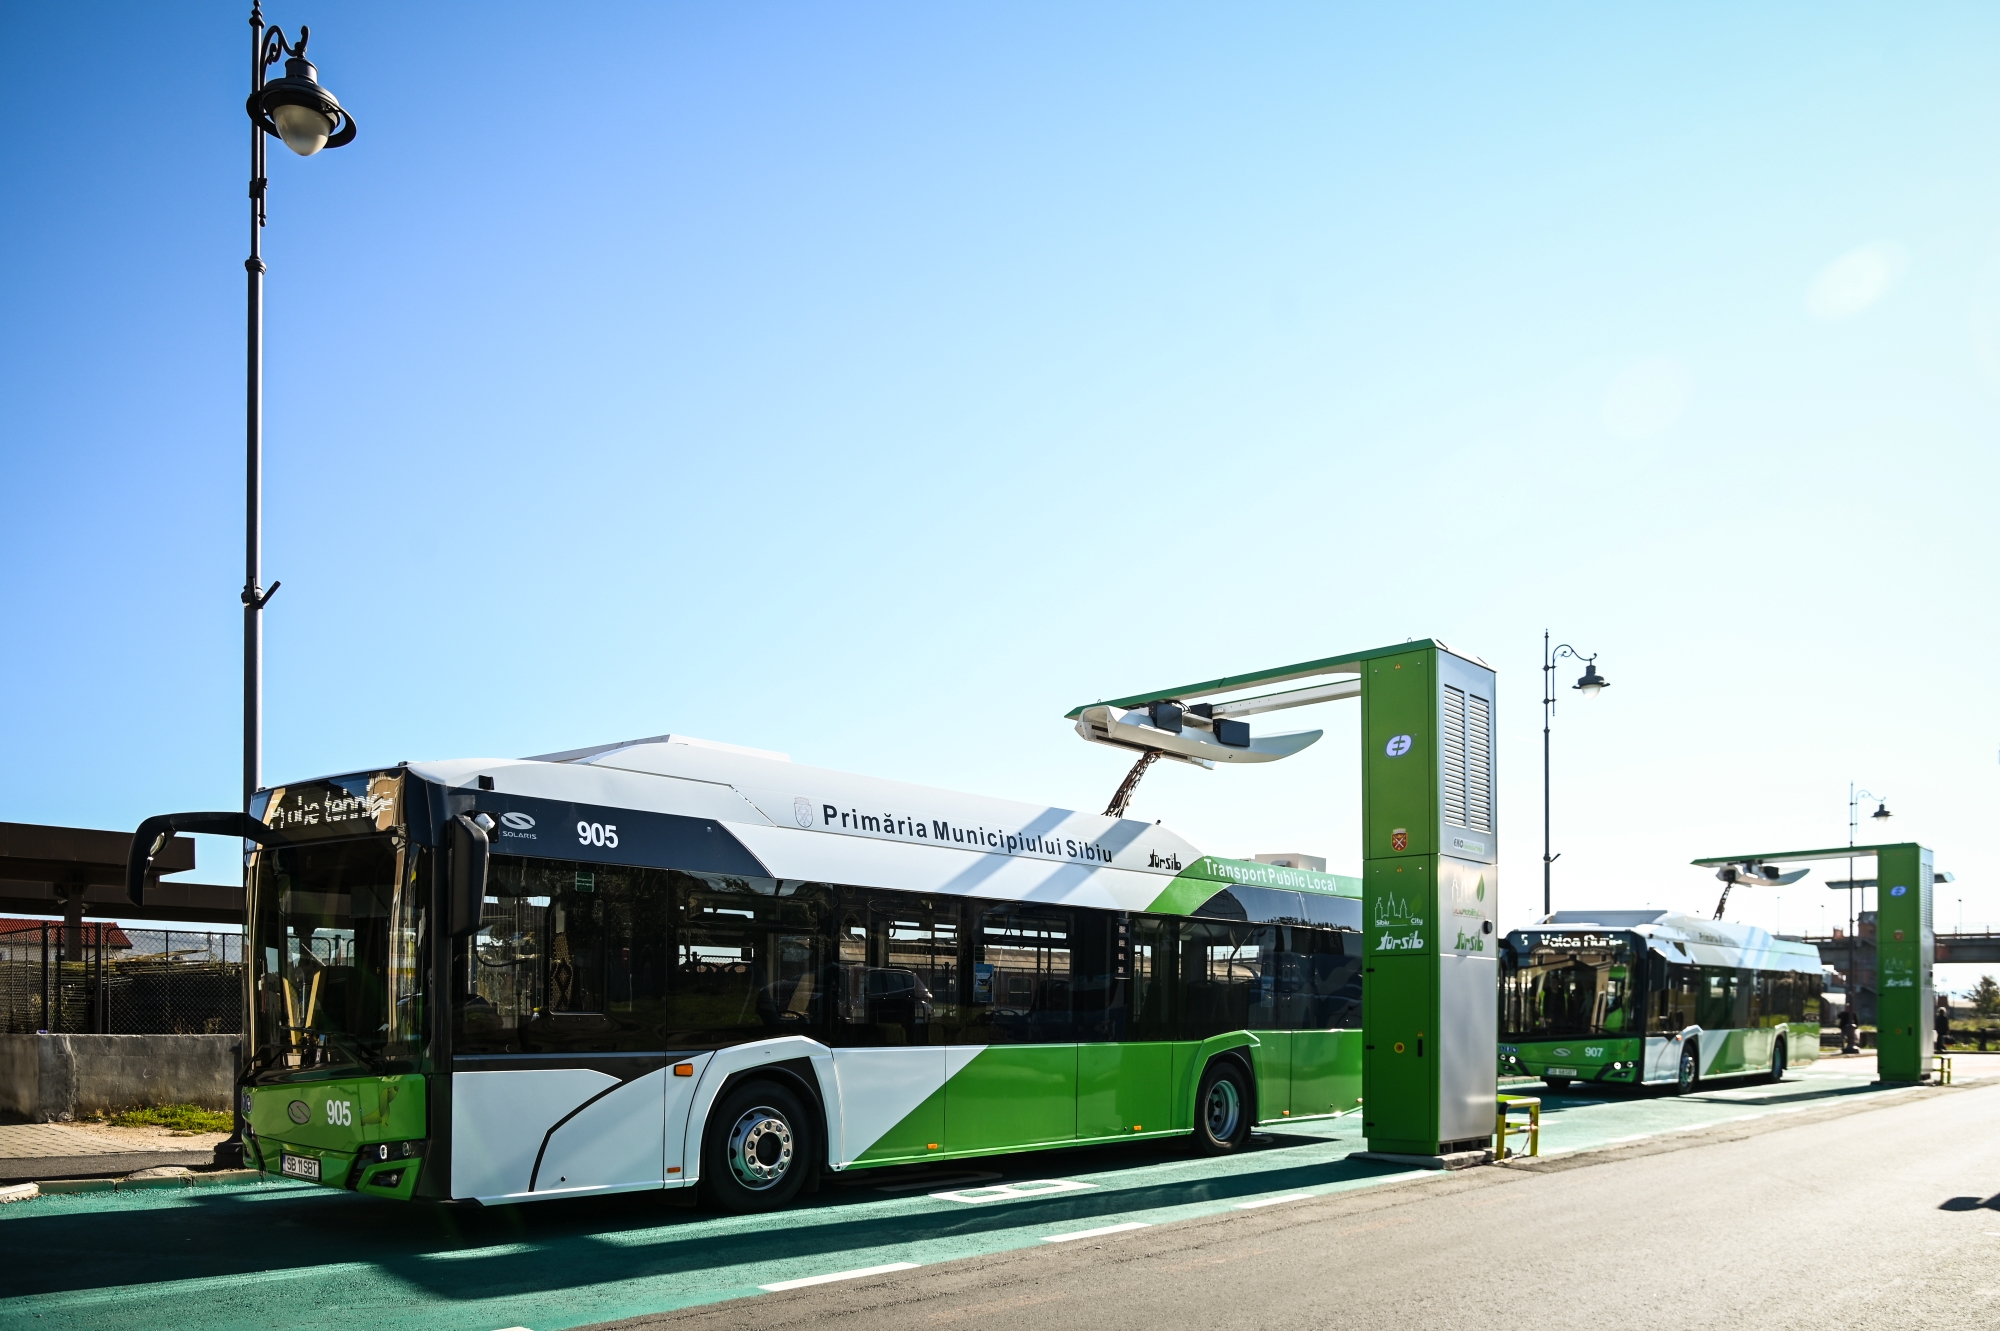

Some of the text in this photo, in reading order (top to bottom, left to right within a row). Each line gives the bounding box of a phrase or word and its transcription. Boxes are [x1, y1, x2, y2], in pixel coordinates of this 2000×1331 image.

[502, 830, 537, 840] SOLARIS
[577, 820, 619, 849] 905
[822, 803, 1113, 863] Primăria Municipiului Sibiu
[1203, 858, 1337, 892] Transport Public Local
[1410, 917, 1423, 926] City
[1520, 934, 1529, 946] 5
[1584, 1046, 1604, 1057] 907
[326, 1099, 352, 1127] 905
[286, 1156, 297, 1172] SB
[297, 1157, 303, 1174] 11
[303, 1160, 317, 1176] SBT
